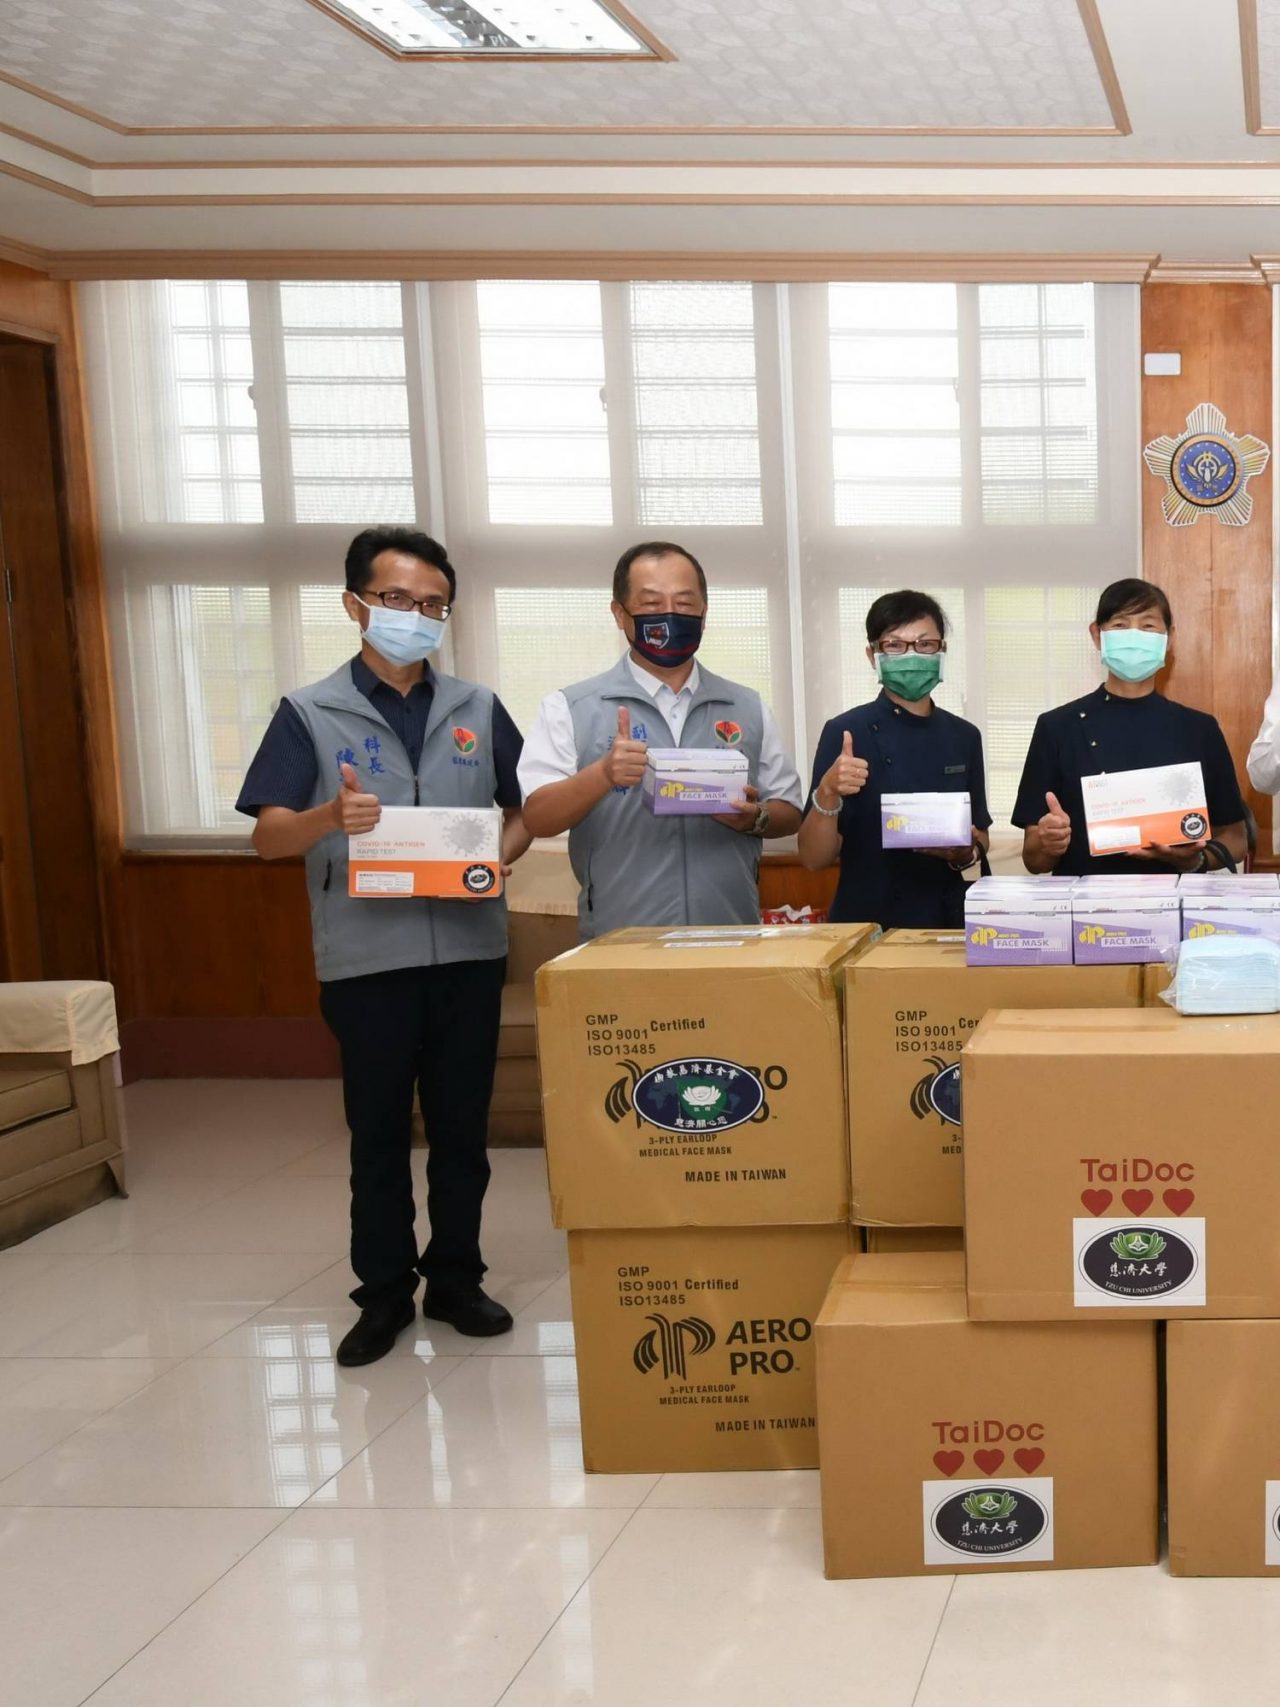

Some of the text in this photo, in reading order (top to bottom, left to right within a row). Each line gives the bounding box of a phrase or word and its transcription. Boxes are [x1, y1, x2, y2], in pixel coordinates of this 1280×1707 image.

[364, 736, 385, 775] 科長
[997, 939, 1049, 947] FACE MASK
[1104, 937, 1157, 946] FACE MASK
[586, 1014, 618, 1026] GMP
[895, 1010, 928, 1021] GMP
[587, 1018, 705, 1041] ISO 9001 Certified
[896, 1026, 956, 1037] ISO 9001
[588, 1043, 656, 1056] ISO13485
[896, 1041, 963, 1052] ISO13485
[649, 1134, 717, 1145] 3-PLY EARLOOP
[639, 1146, 732, 1157] MEDICAL FACE MASK
[685, 1169, 786, 1182] MADE IN TAIWAN
[1080, 1158, 1195, 1183] TaiDoc
[618, 1266, 650, 1277] GMP
[1109, 1261, 1168, 1278] 慈濟大學
[619, 1279, 739, 1292] ISO 9001 Certified
[1105, 1280, 1172, 1294] TZU CHI UNIVERSITY
[620, 1294, 686, 1306] ISO13485
[725, 1318, 812, 1345] AERO
[730, 1350, 794, 1376] PRO
[670, 1384, 736, 1394] 3-PLY EARLOOP
[660, 1394, 750, 1405] MEDICAL FACE MASK
[716, 1417, 815, 1432] MADE IN TAIWAN
[932, 1420, 1045, 1445] TaiDoc
[961, 1520, 1019, 1536] 慈濟大學
[957, 1537, 1024, 1552] TZU CHI UNIVERSITY
